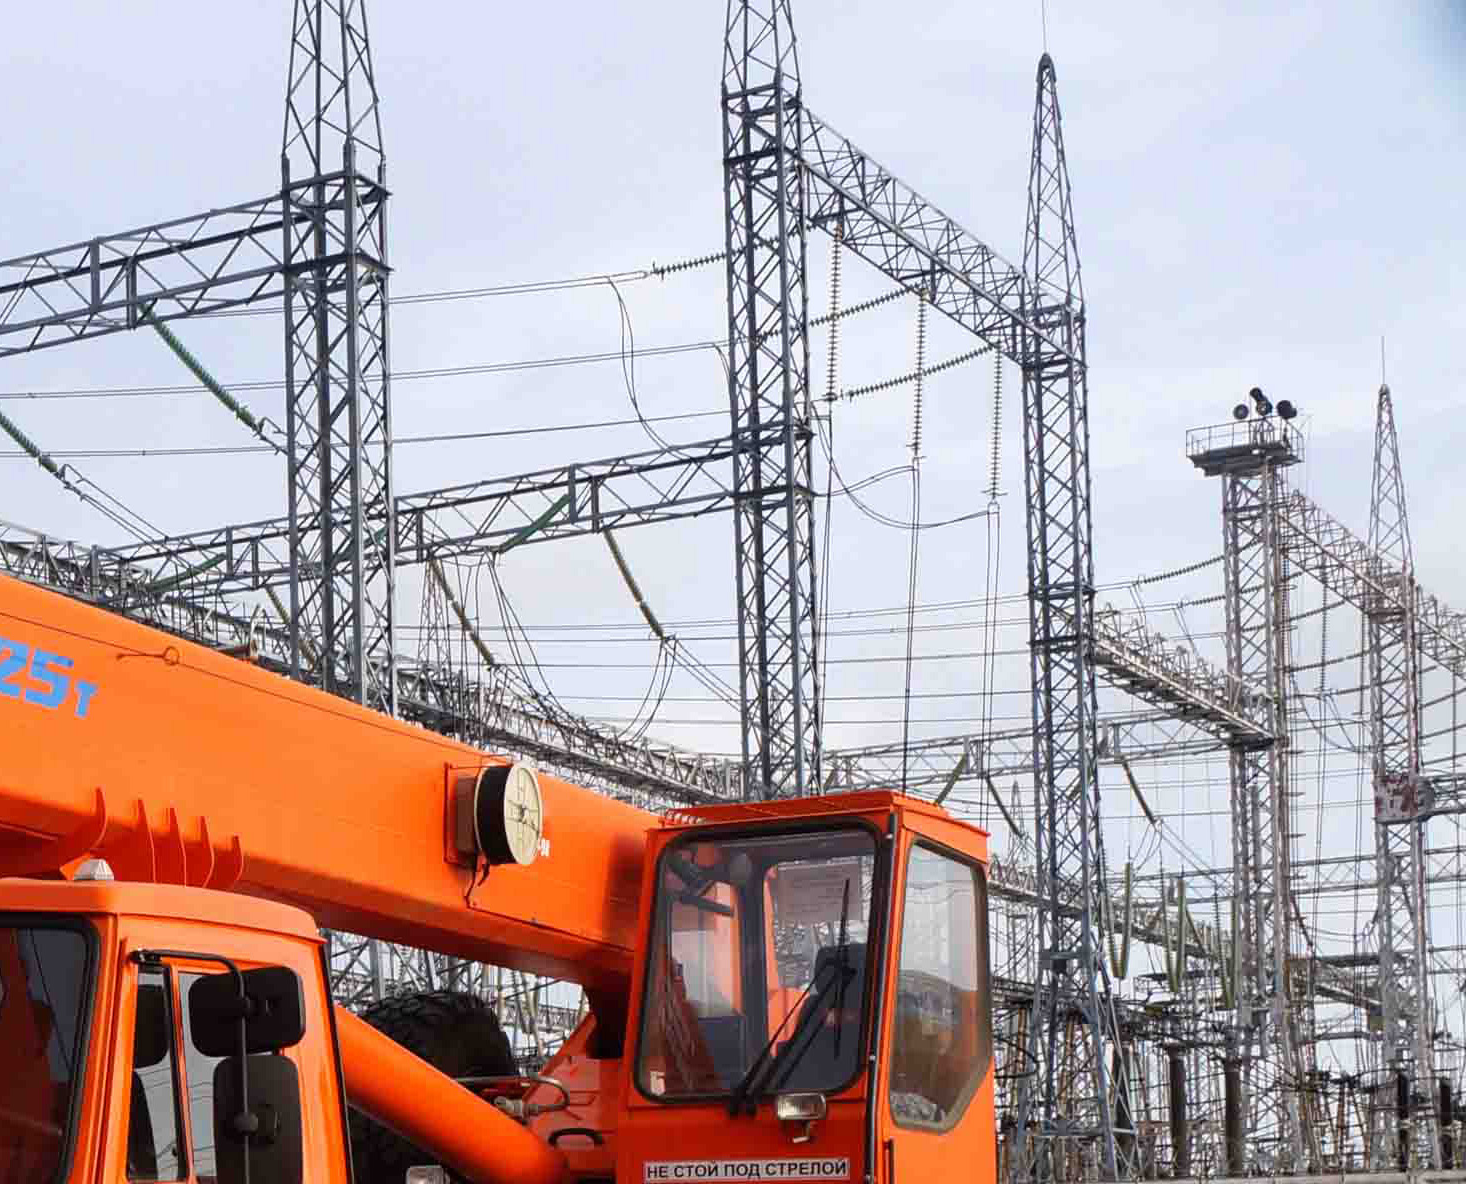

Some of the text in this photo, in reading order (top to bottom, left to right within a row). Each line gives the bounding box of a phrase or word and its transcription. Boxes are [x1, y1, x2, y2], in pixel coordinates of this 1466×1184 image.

[647, 1159, 847, 1180] НЕ СТОЙ ПОД СТРЕЛОЙ
